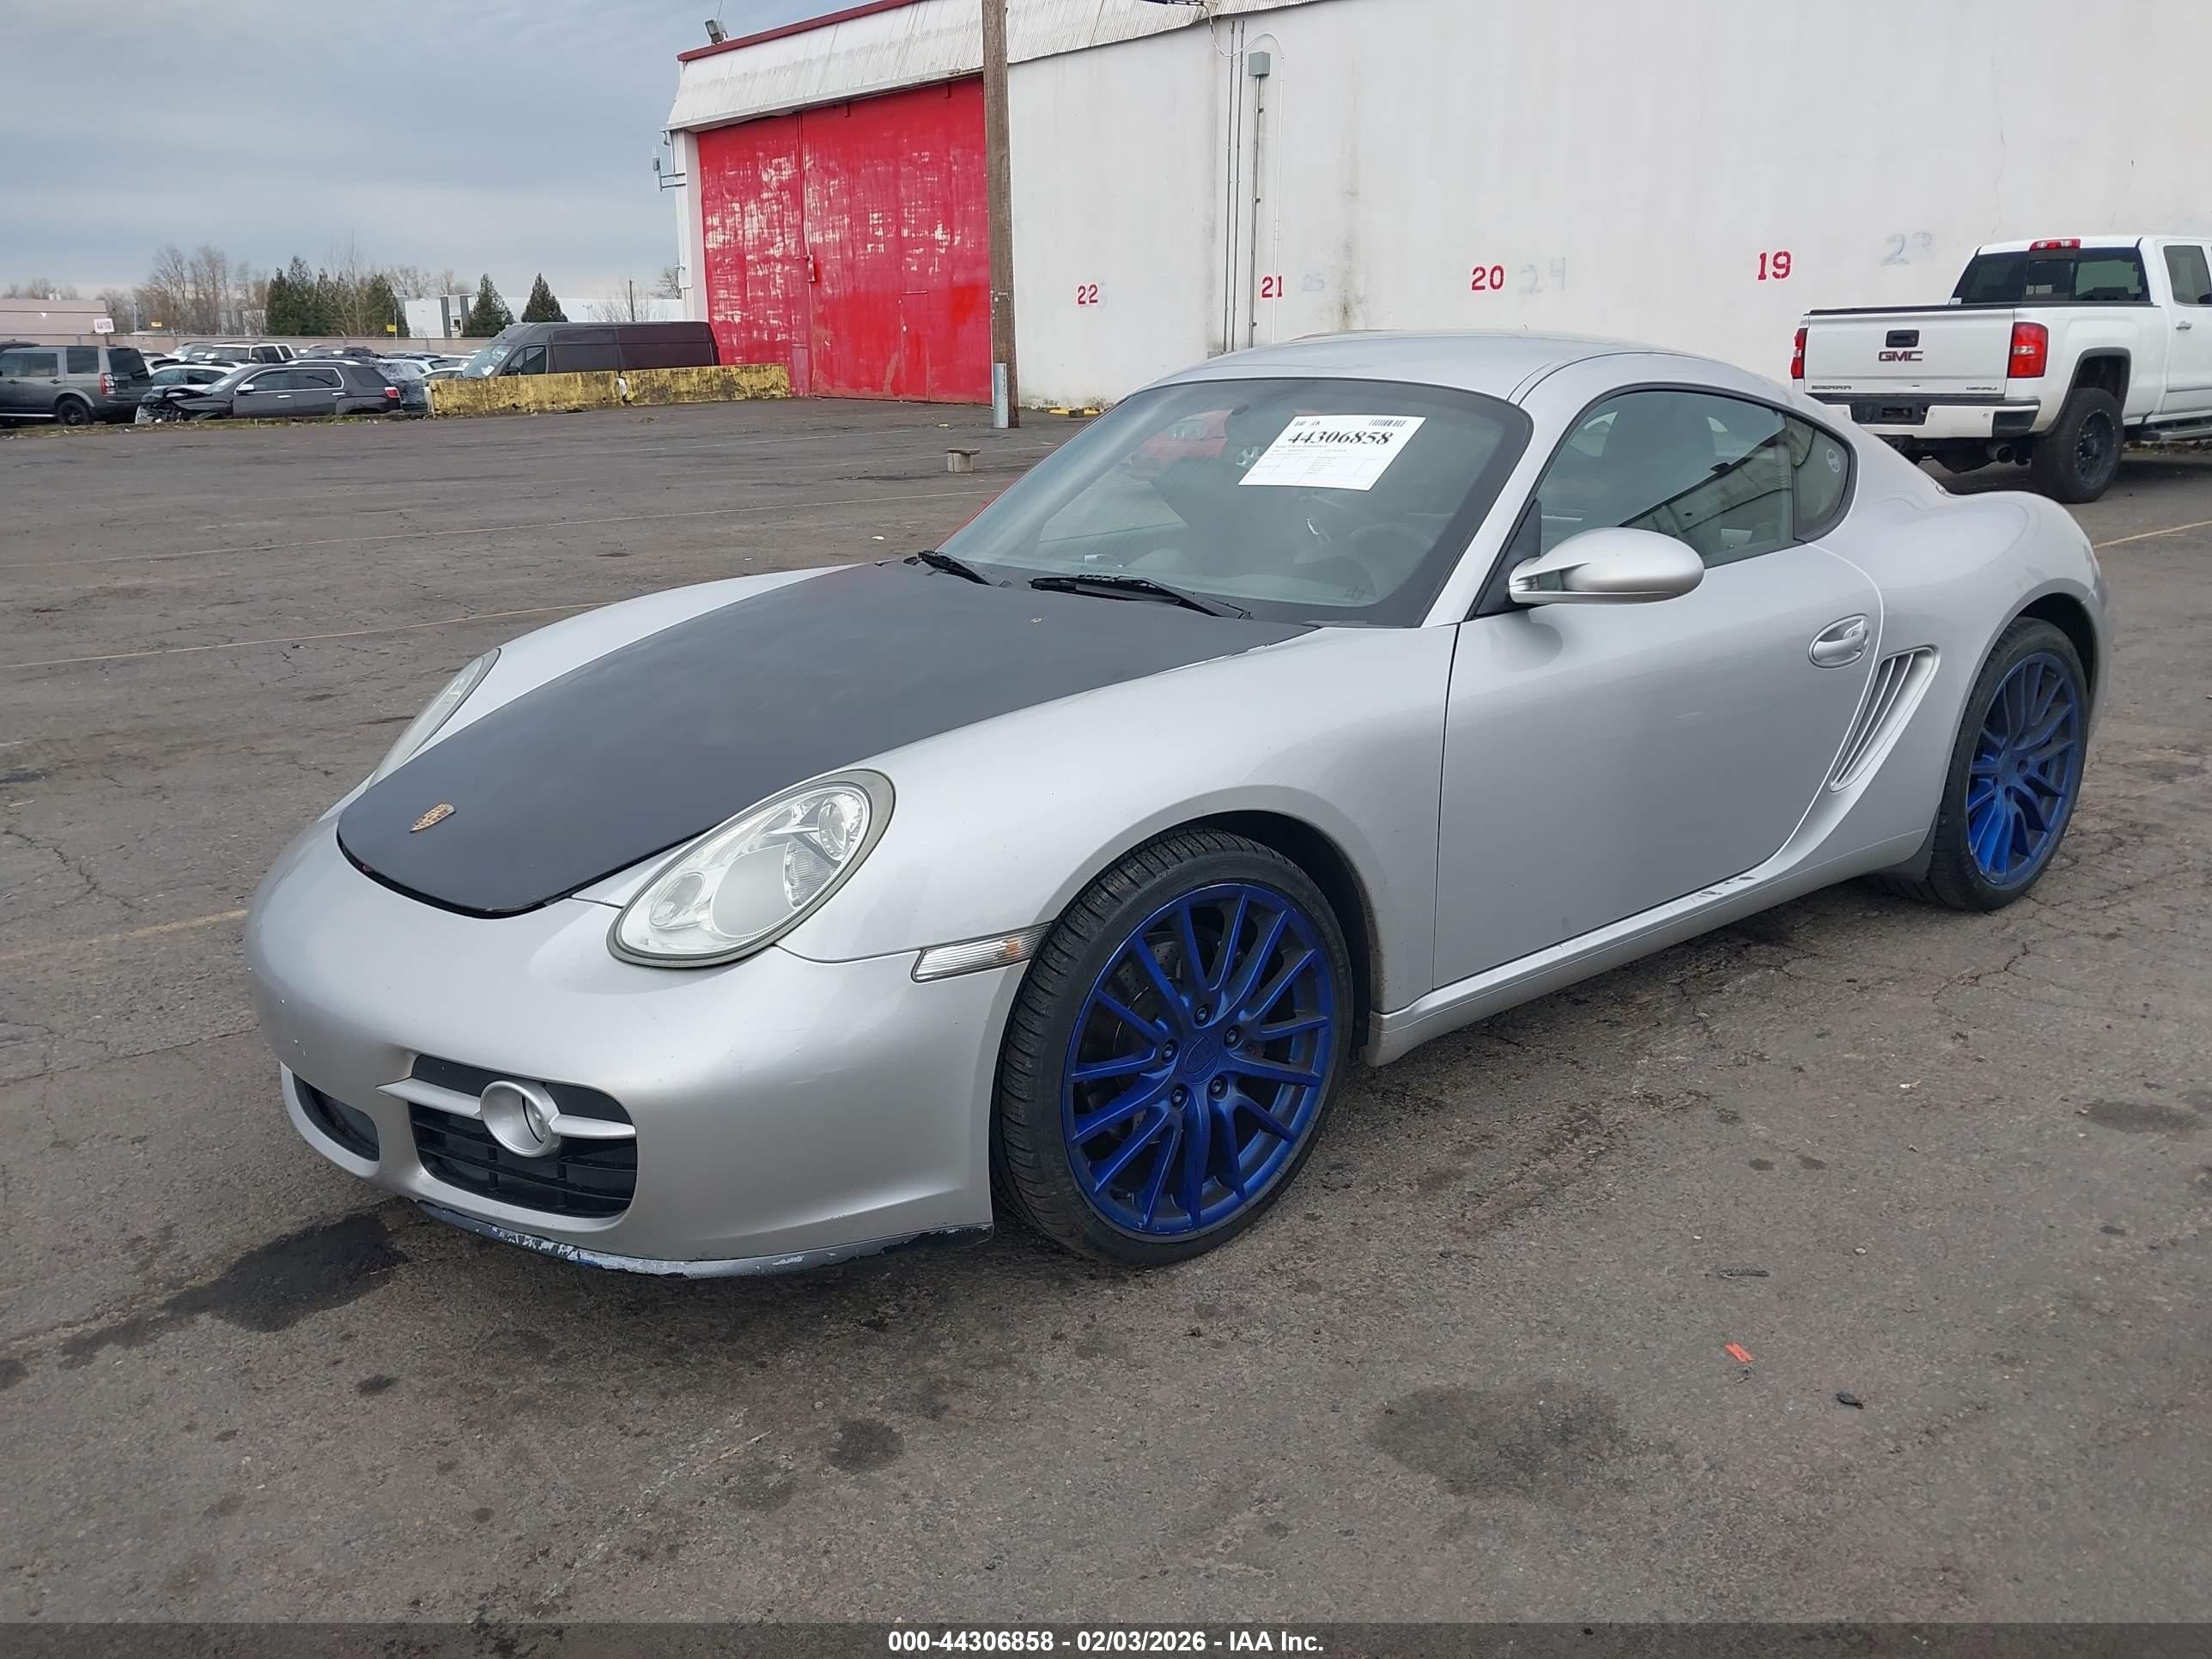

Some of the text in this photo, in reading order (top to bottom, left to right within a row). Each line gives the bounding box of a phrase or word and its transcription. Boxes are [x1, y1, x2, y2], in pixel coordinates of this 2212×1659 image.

[1471, 264, 1504, 290] 20
[1758, 251, 1791, 281] 19
[1078, 283, 1098, 305] 22
[1261, 276, 1283, 298] 21
[1878, 350, 1923, 362] GMC
[1287, 430, 1395, 446] 44306858
